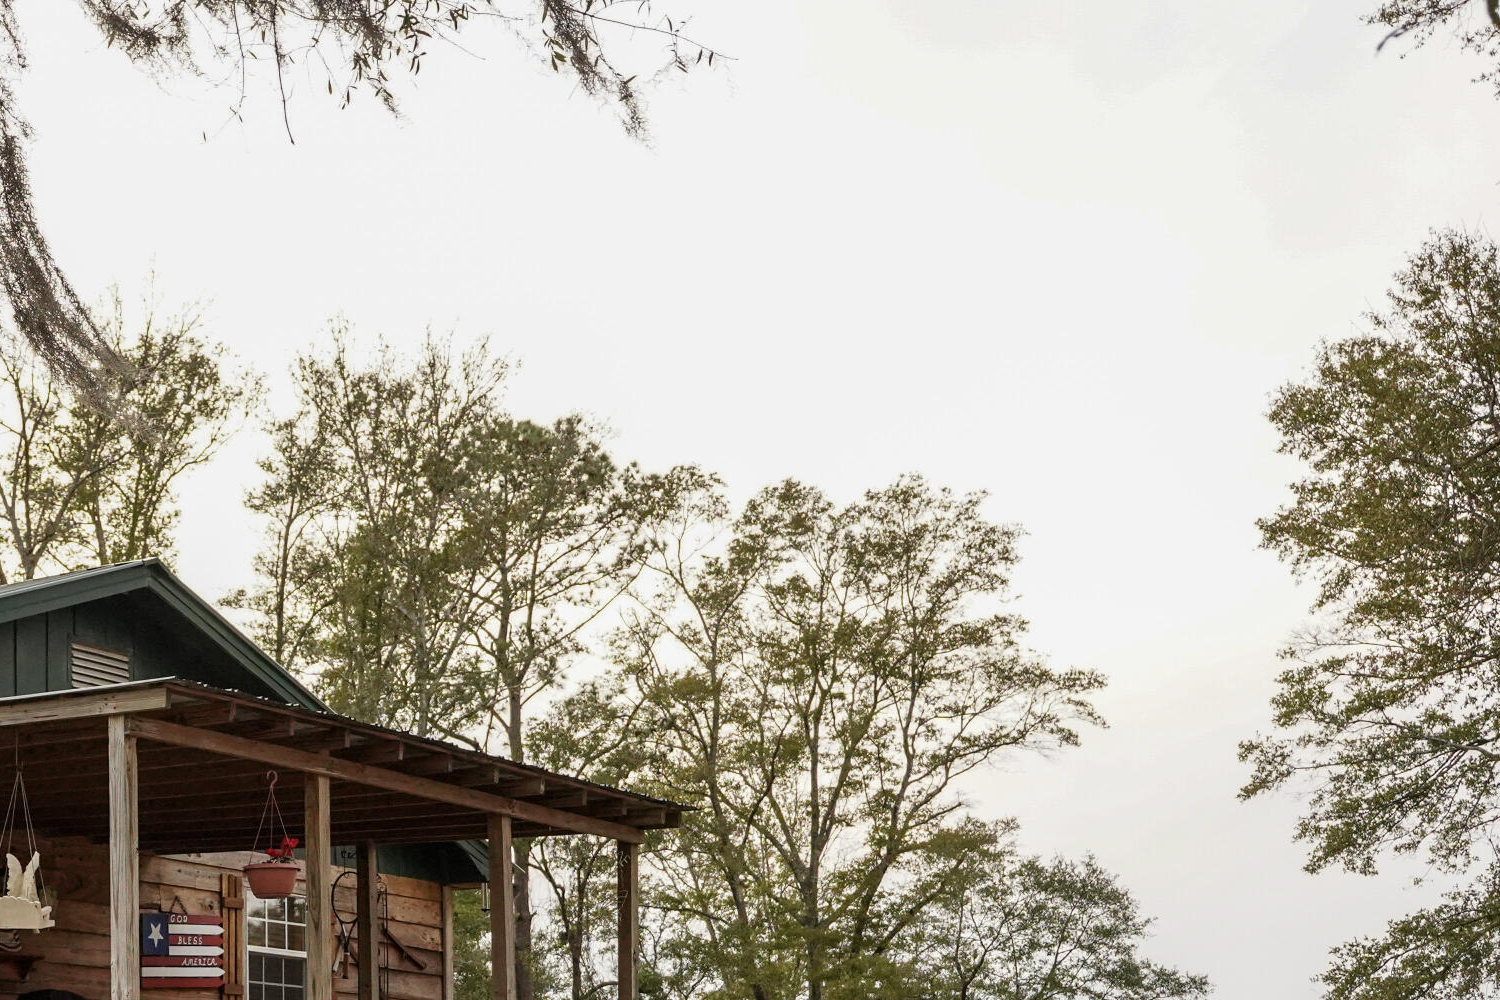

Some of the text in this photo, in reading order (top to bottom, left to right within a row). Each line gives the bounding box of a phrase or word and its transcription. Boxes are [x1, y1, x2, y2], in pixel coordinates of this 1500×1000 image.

[170, 914, 188, 923] GOD
[177, 936, 203, 945] BLESS
[181, 957, 218, 966] AMERICA
